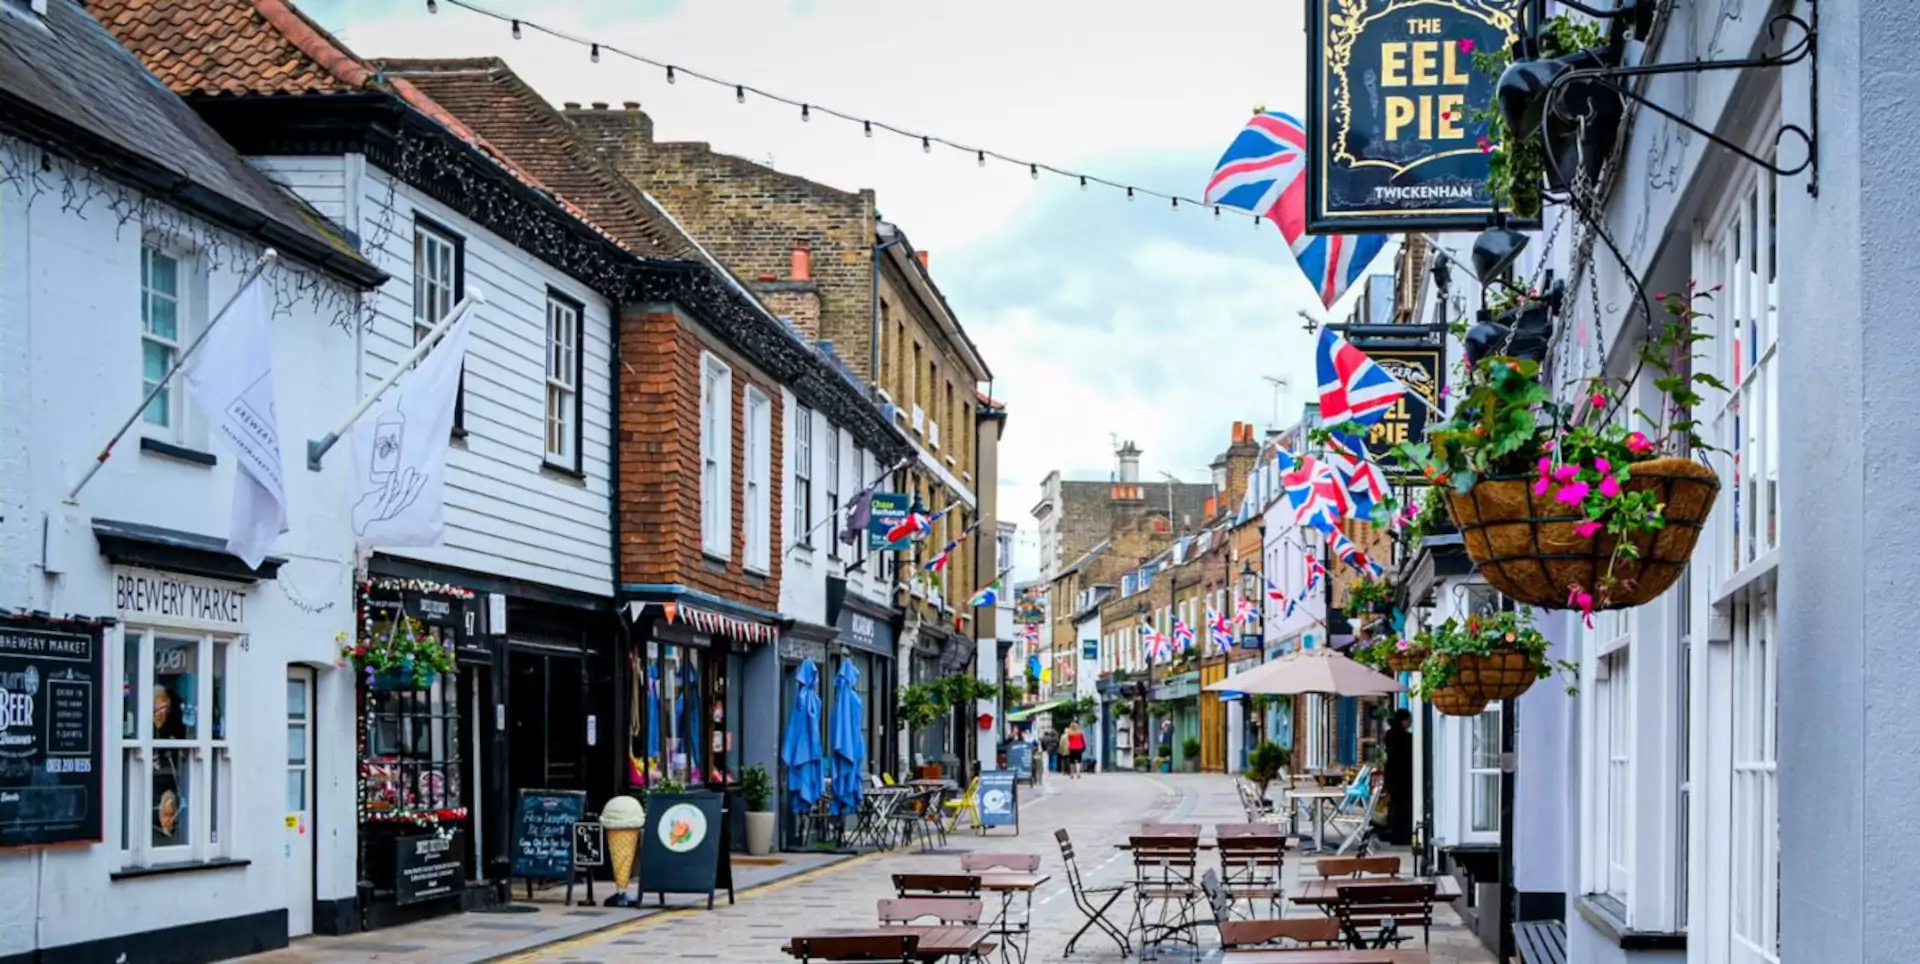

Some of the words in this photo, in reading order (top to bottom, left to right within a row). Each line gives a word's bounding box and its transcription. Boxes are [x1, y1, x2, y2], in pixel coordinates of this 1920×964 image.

[1407, 19, 1441, 34] THE
[1381, 41, 1469, 87] EEL
[1385, 94, 1464, 141] PIE
[1375, 186, 1473, 200] TWICKENHAM
[234, 406, 274, 445] BREWERY
[1370, 423, 1409, 445] PIE
[871, 499, 895, 509] Chase
[117, 575, 186, 616] BREWERY
[190, 585, 247, 623] MARKET
[49, 640, 86, 654] MARKET
